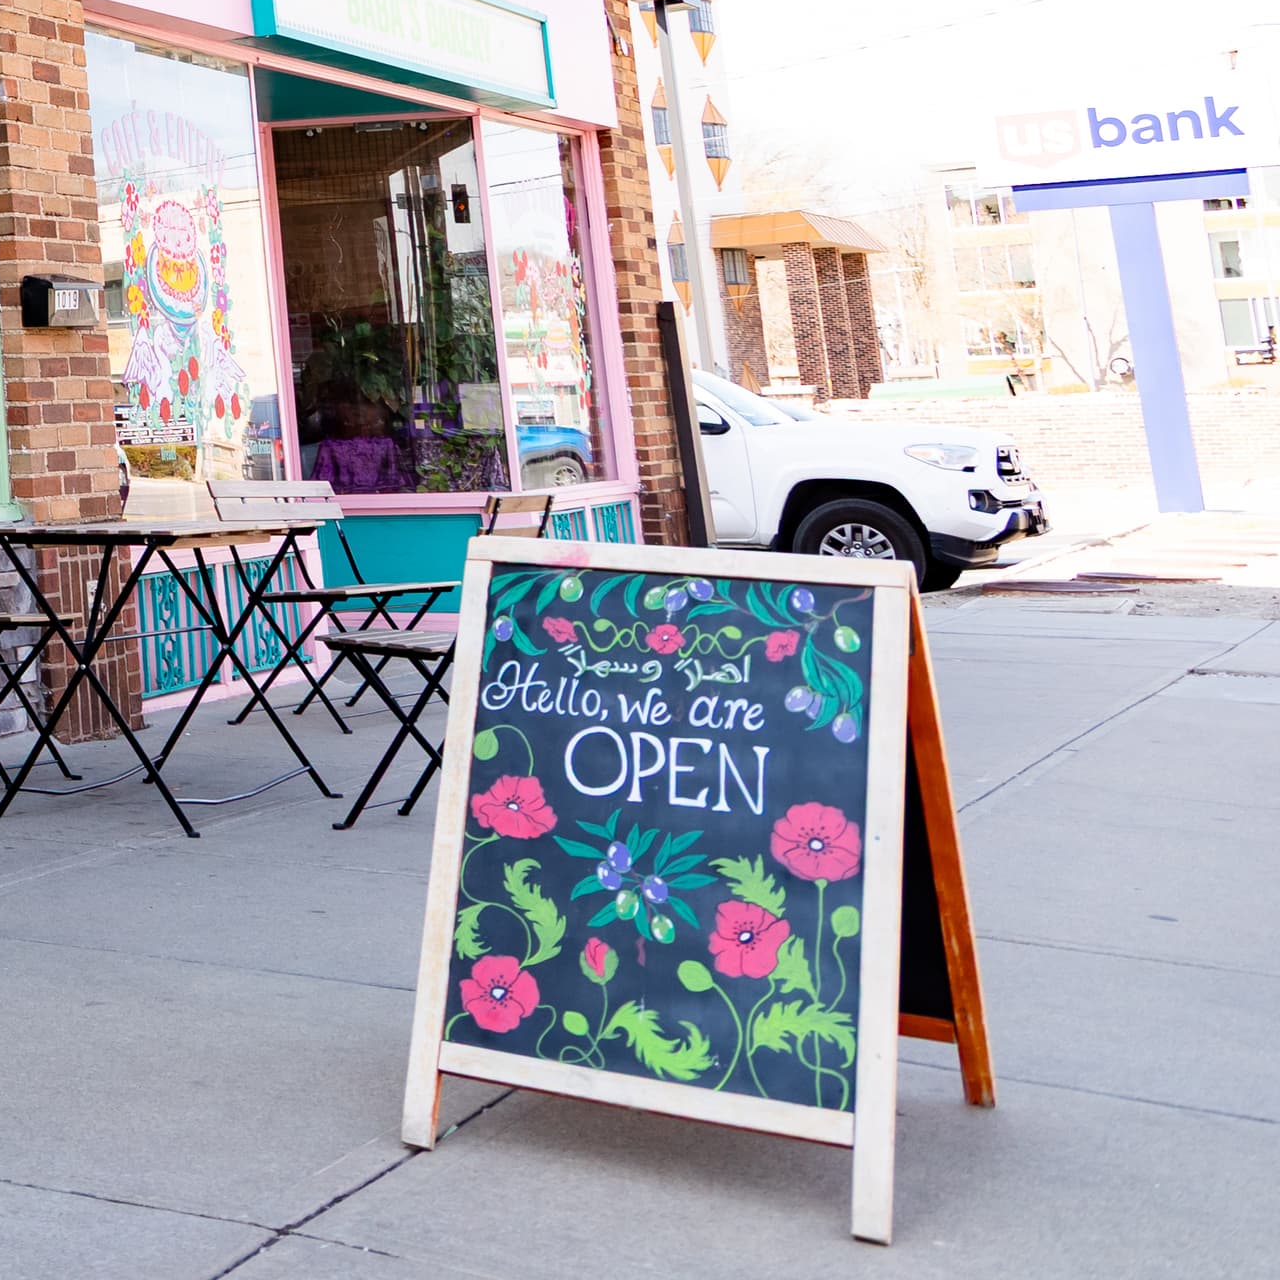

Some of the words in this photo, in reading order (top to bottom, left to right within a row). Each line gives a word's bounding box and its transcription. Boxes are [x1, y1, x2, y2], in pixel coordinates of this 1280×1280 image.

[1087, 96, 1246, 149] bank
[482, 660, 609, 722] Hello,
[689, 694, 765, 731] are
[564, 725, 769, 815] OPEN
